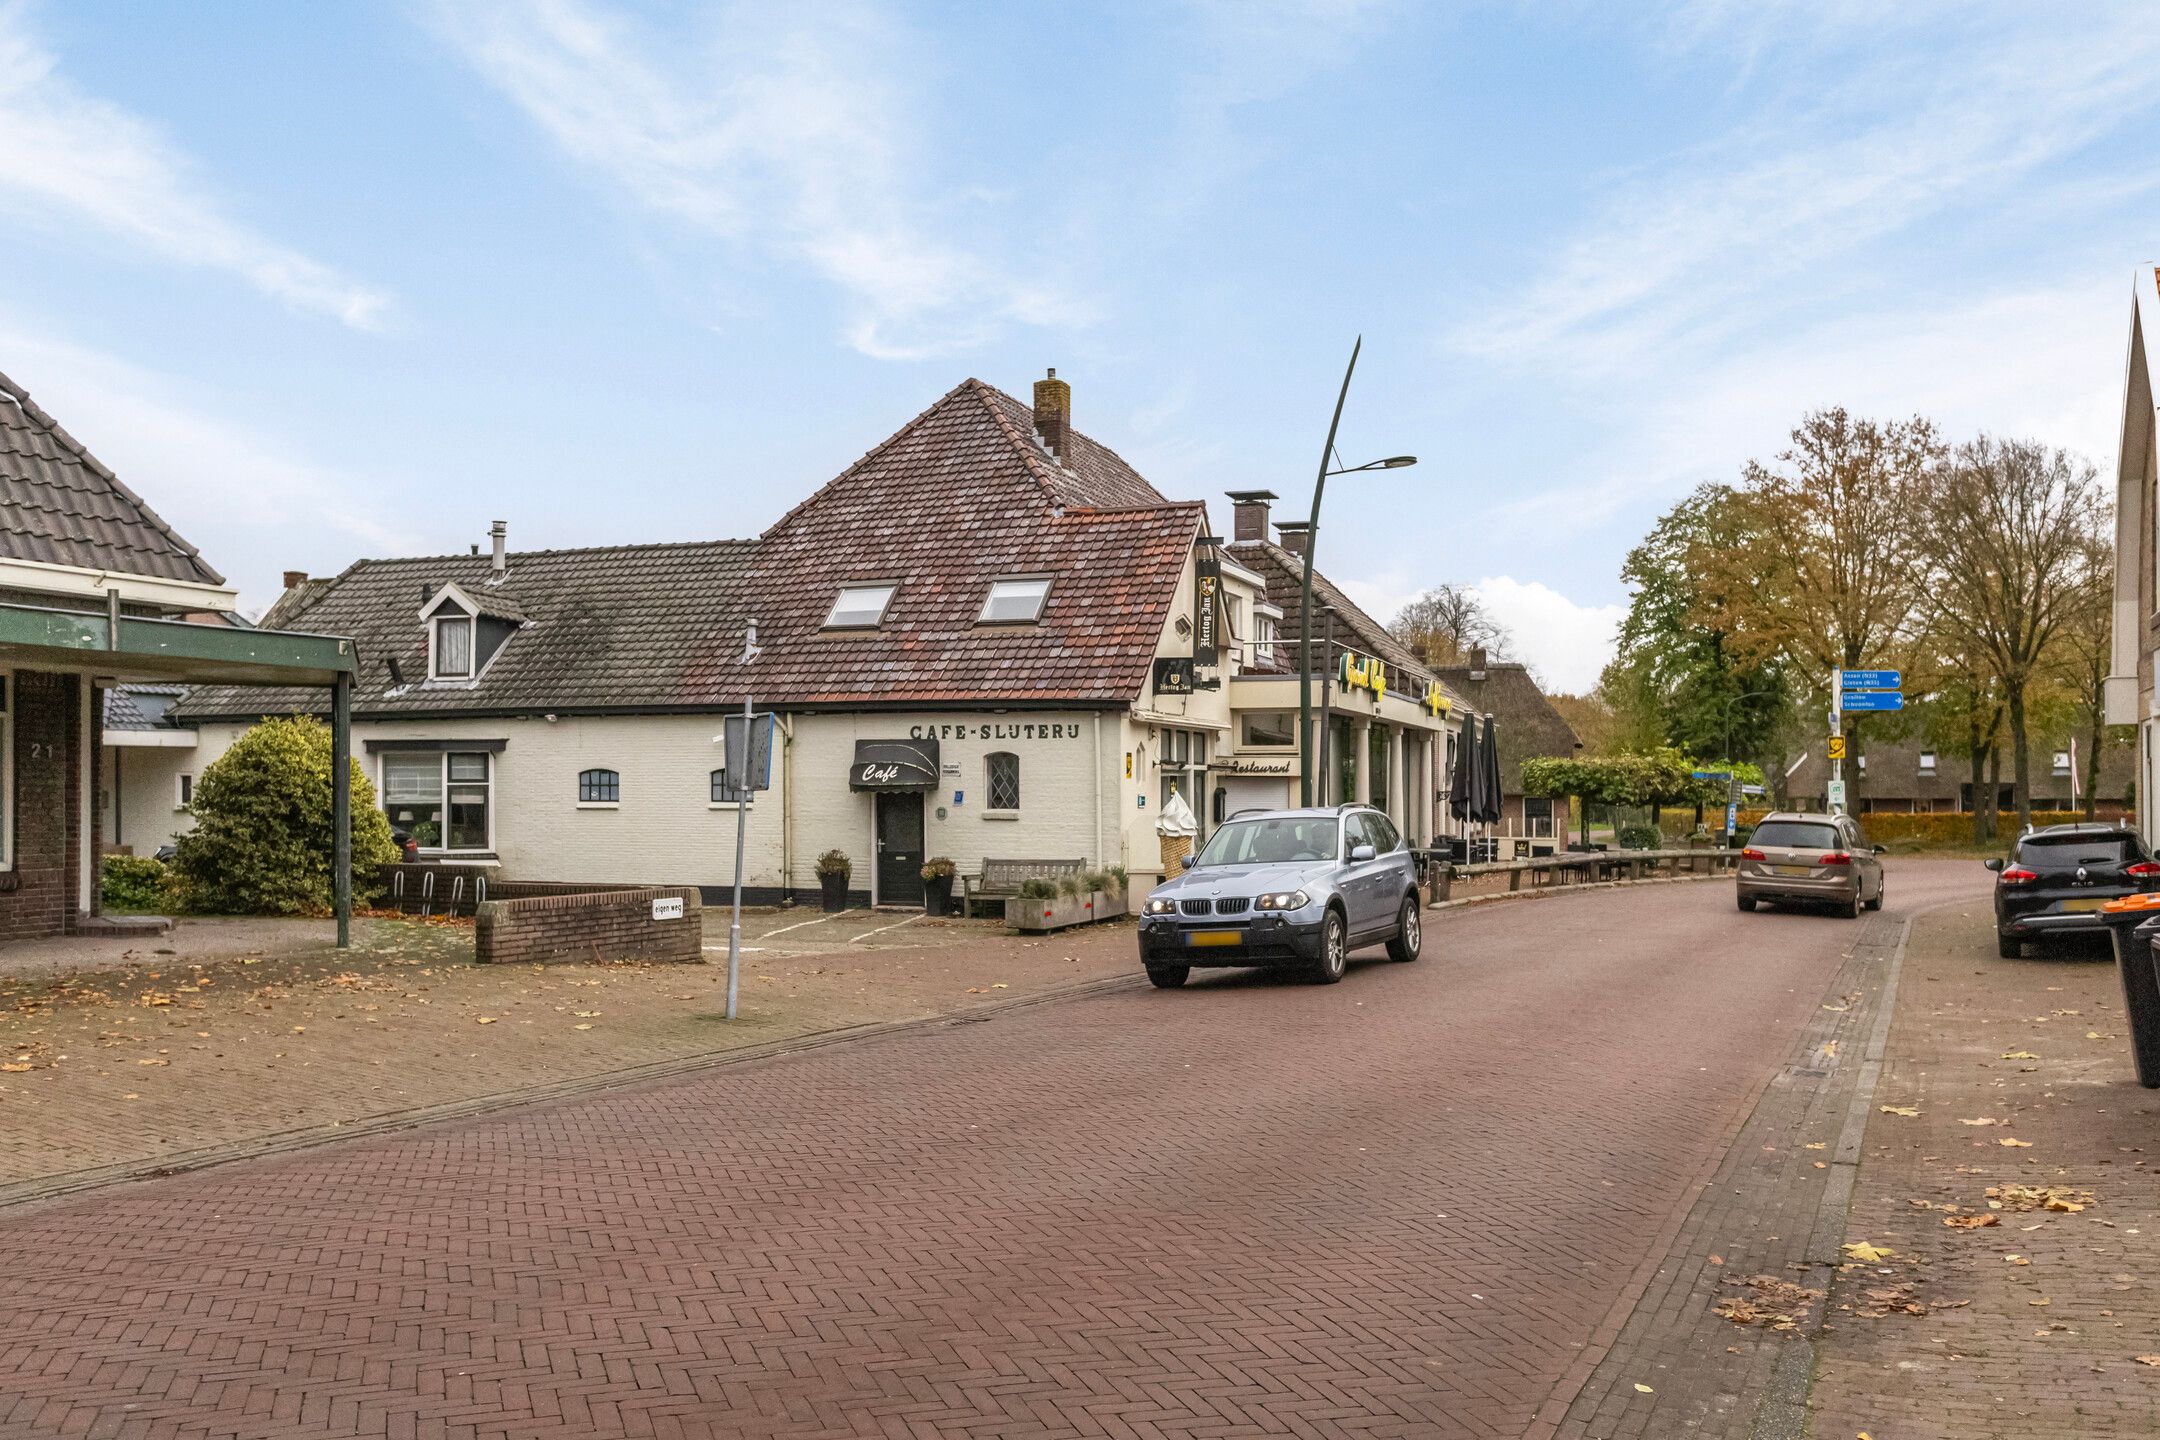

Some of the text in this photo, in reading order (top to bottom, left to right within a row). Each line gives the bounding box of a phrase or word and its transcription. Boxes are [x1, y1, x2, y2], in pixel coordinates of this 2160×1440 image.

[1200, 597, 1213, 648] Hertog Jan
[1159, 683, 1191, 691] Hertog Jan
[31, 743, 53, 759] 21
[862, 763, 899, 782] Café
[1230, 760, 1291, 774] Restaurant
[655, 904, 682, 915] eigen weg
